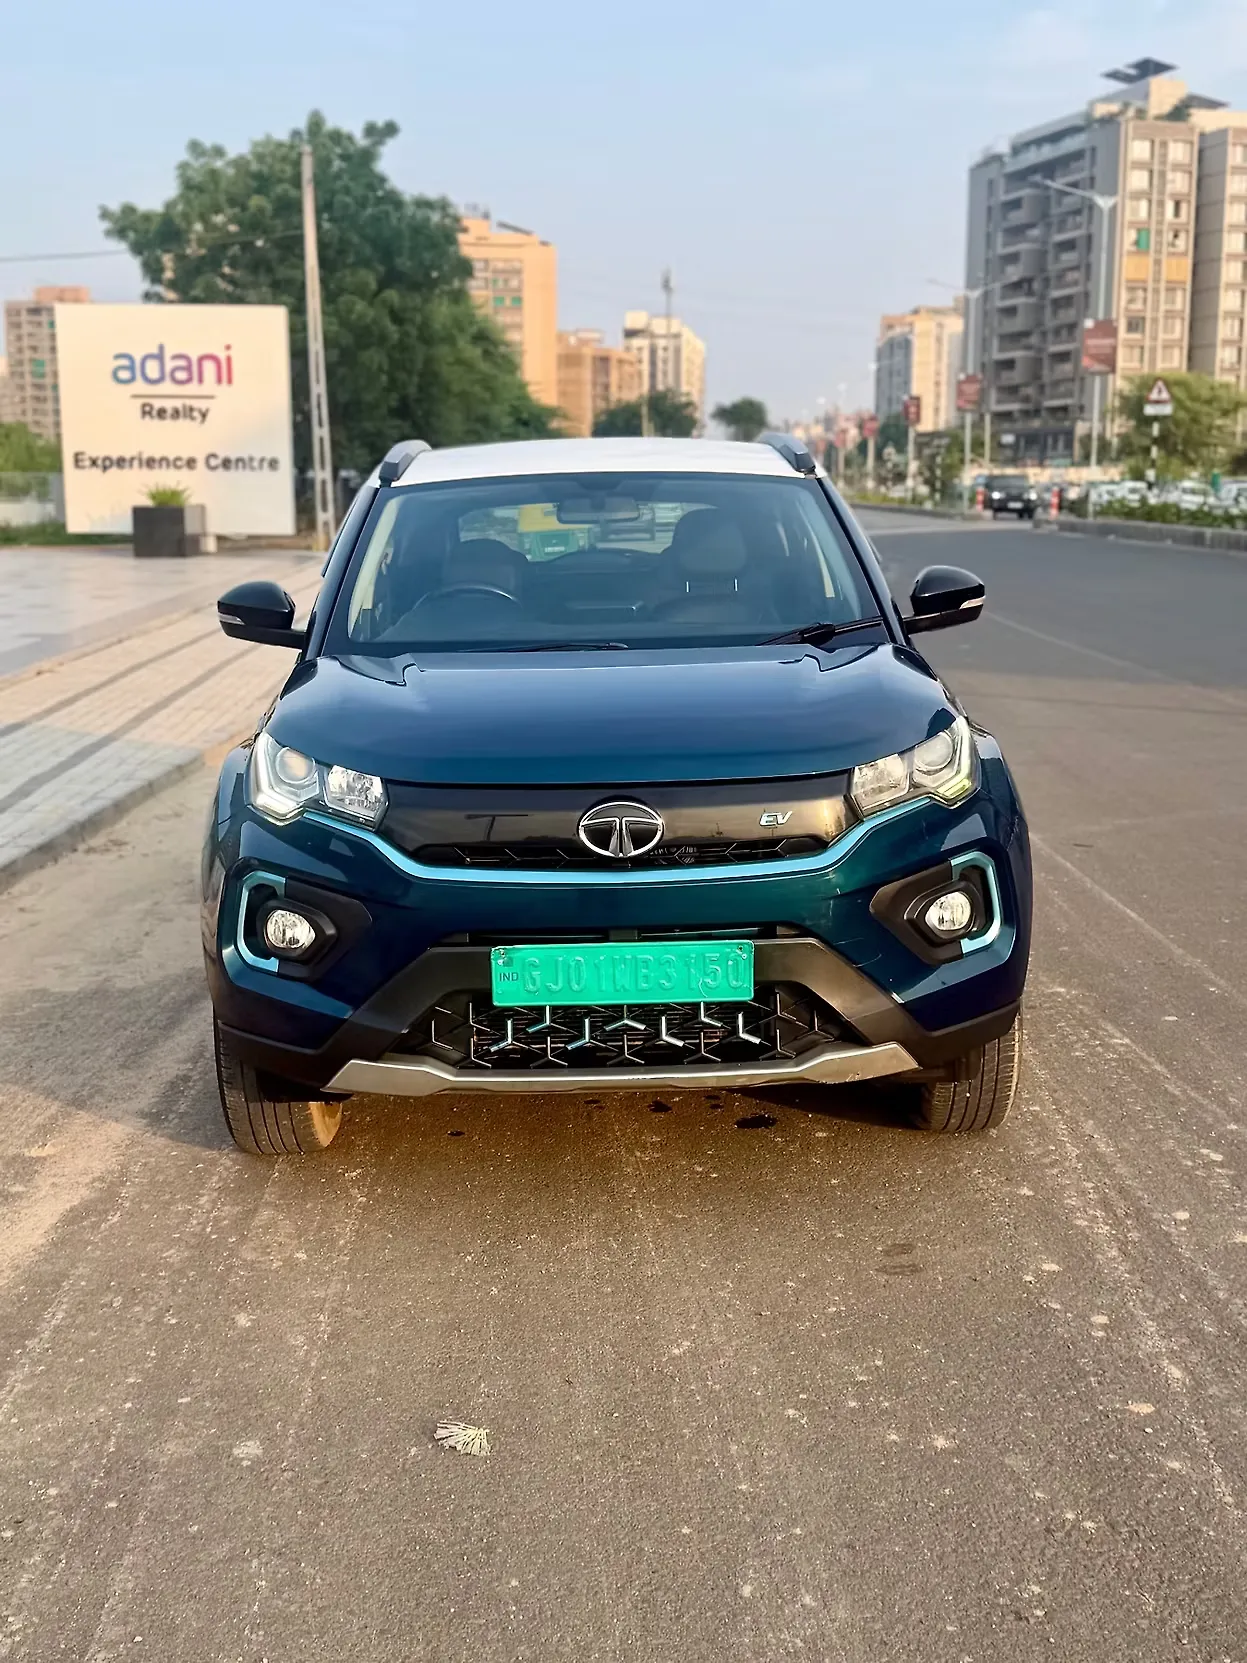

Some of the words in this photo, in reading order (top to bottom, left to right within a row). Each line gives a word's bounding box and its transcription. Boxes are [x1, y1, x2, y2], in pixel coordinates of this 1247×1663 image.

[111, 344, 233, 386] adani
[141, 403, 209, 424] Realty
[74, 452, 197, 473] Experience
[205, 453, 280, 471] Centre
[759, 811, 793, 827] EV
[499, 972, 520, 983] IND
